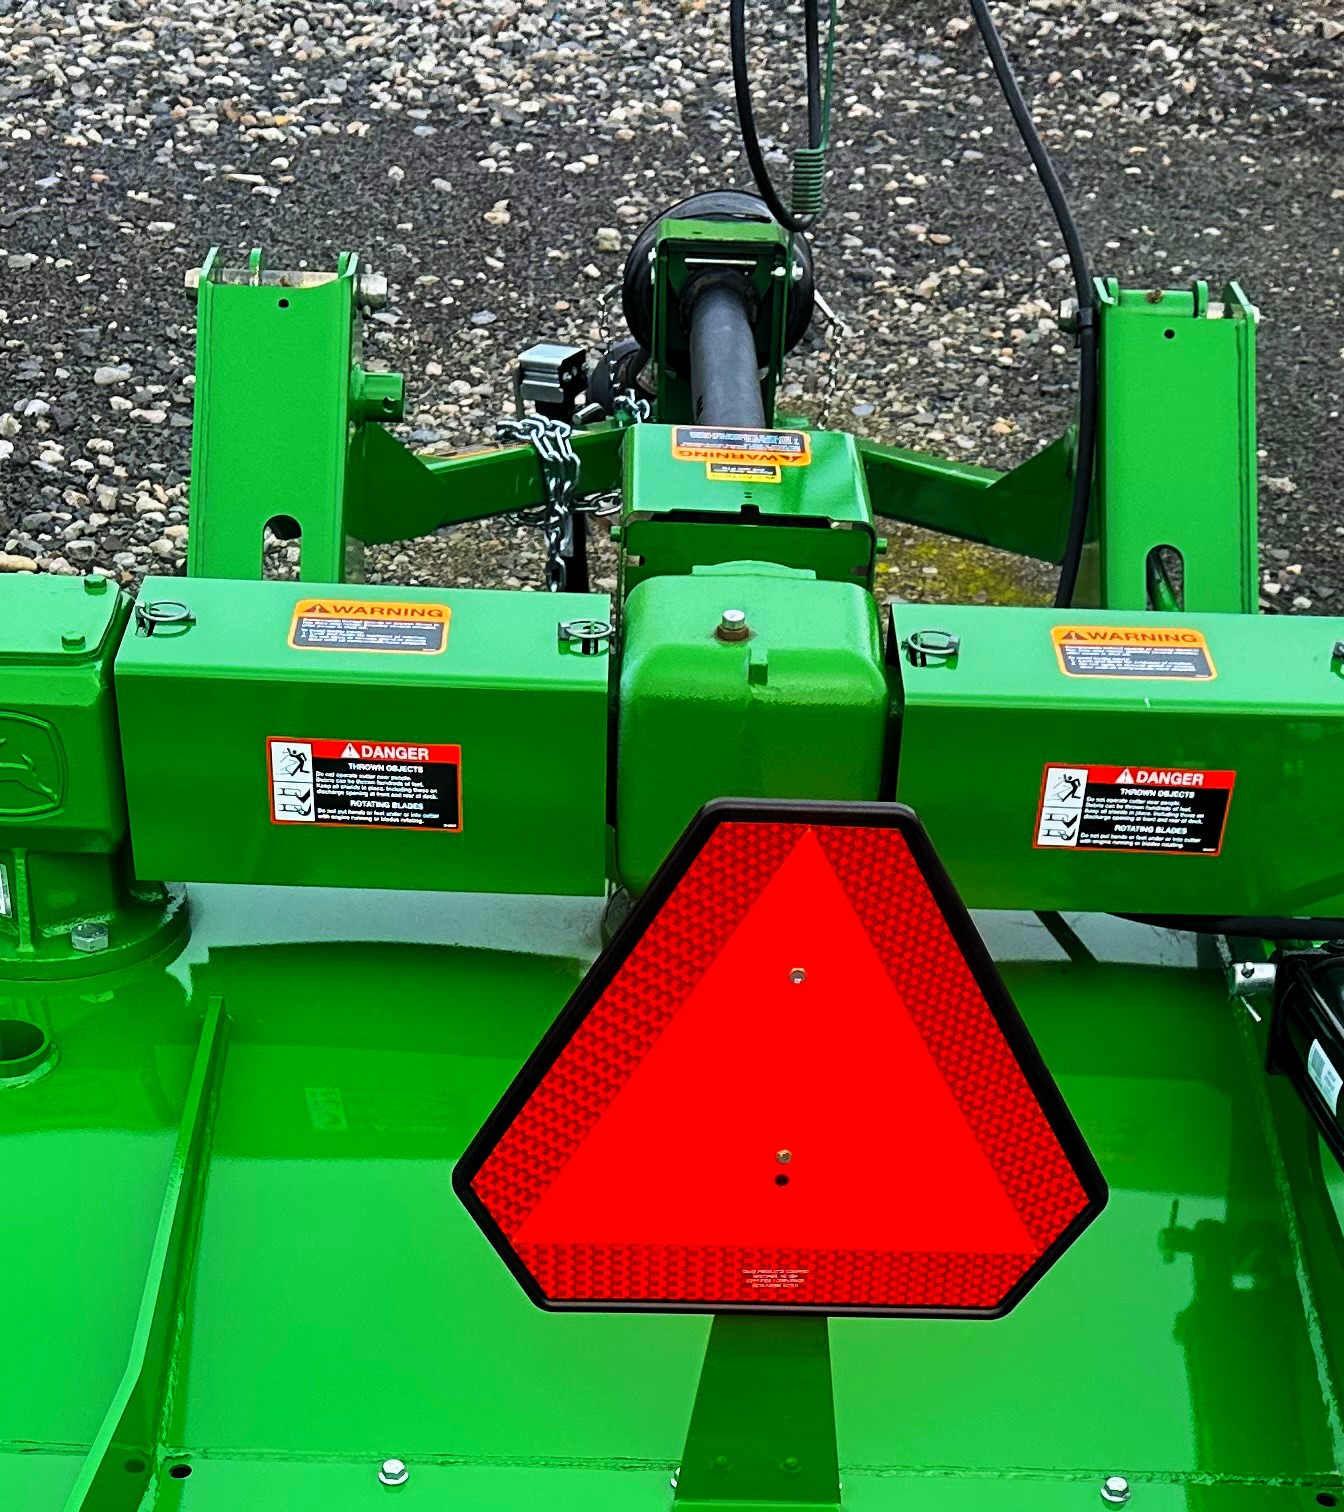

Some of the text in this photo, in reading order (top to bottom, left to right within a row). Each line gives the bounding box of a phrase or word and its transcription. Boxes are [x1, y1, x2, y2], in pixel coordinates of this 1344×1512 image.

[679, 450, 778, 461] WARNING
[333, 605, 443, 617] WARNING
[1087, 632, 1197, 642] WARNING
[361, 745, 429, 760] DANGER
[348, 763, 423, 773] THROWN OBJECTS
[1136, 771, 1203, 786] DANGER
[1120, 788, 1195, 798] THROWN OBJECTS
[350, 800, 424, 810] ROTATING BLADES
[1114, 825, 1187, 834] ROTATING BLADES
